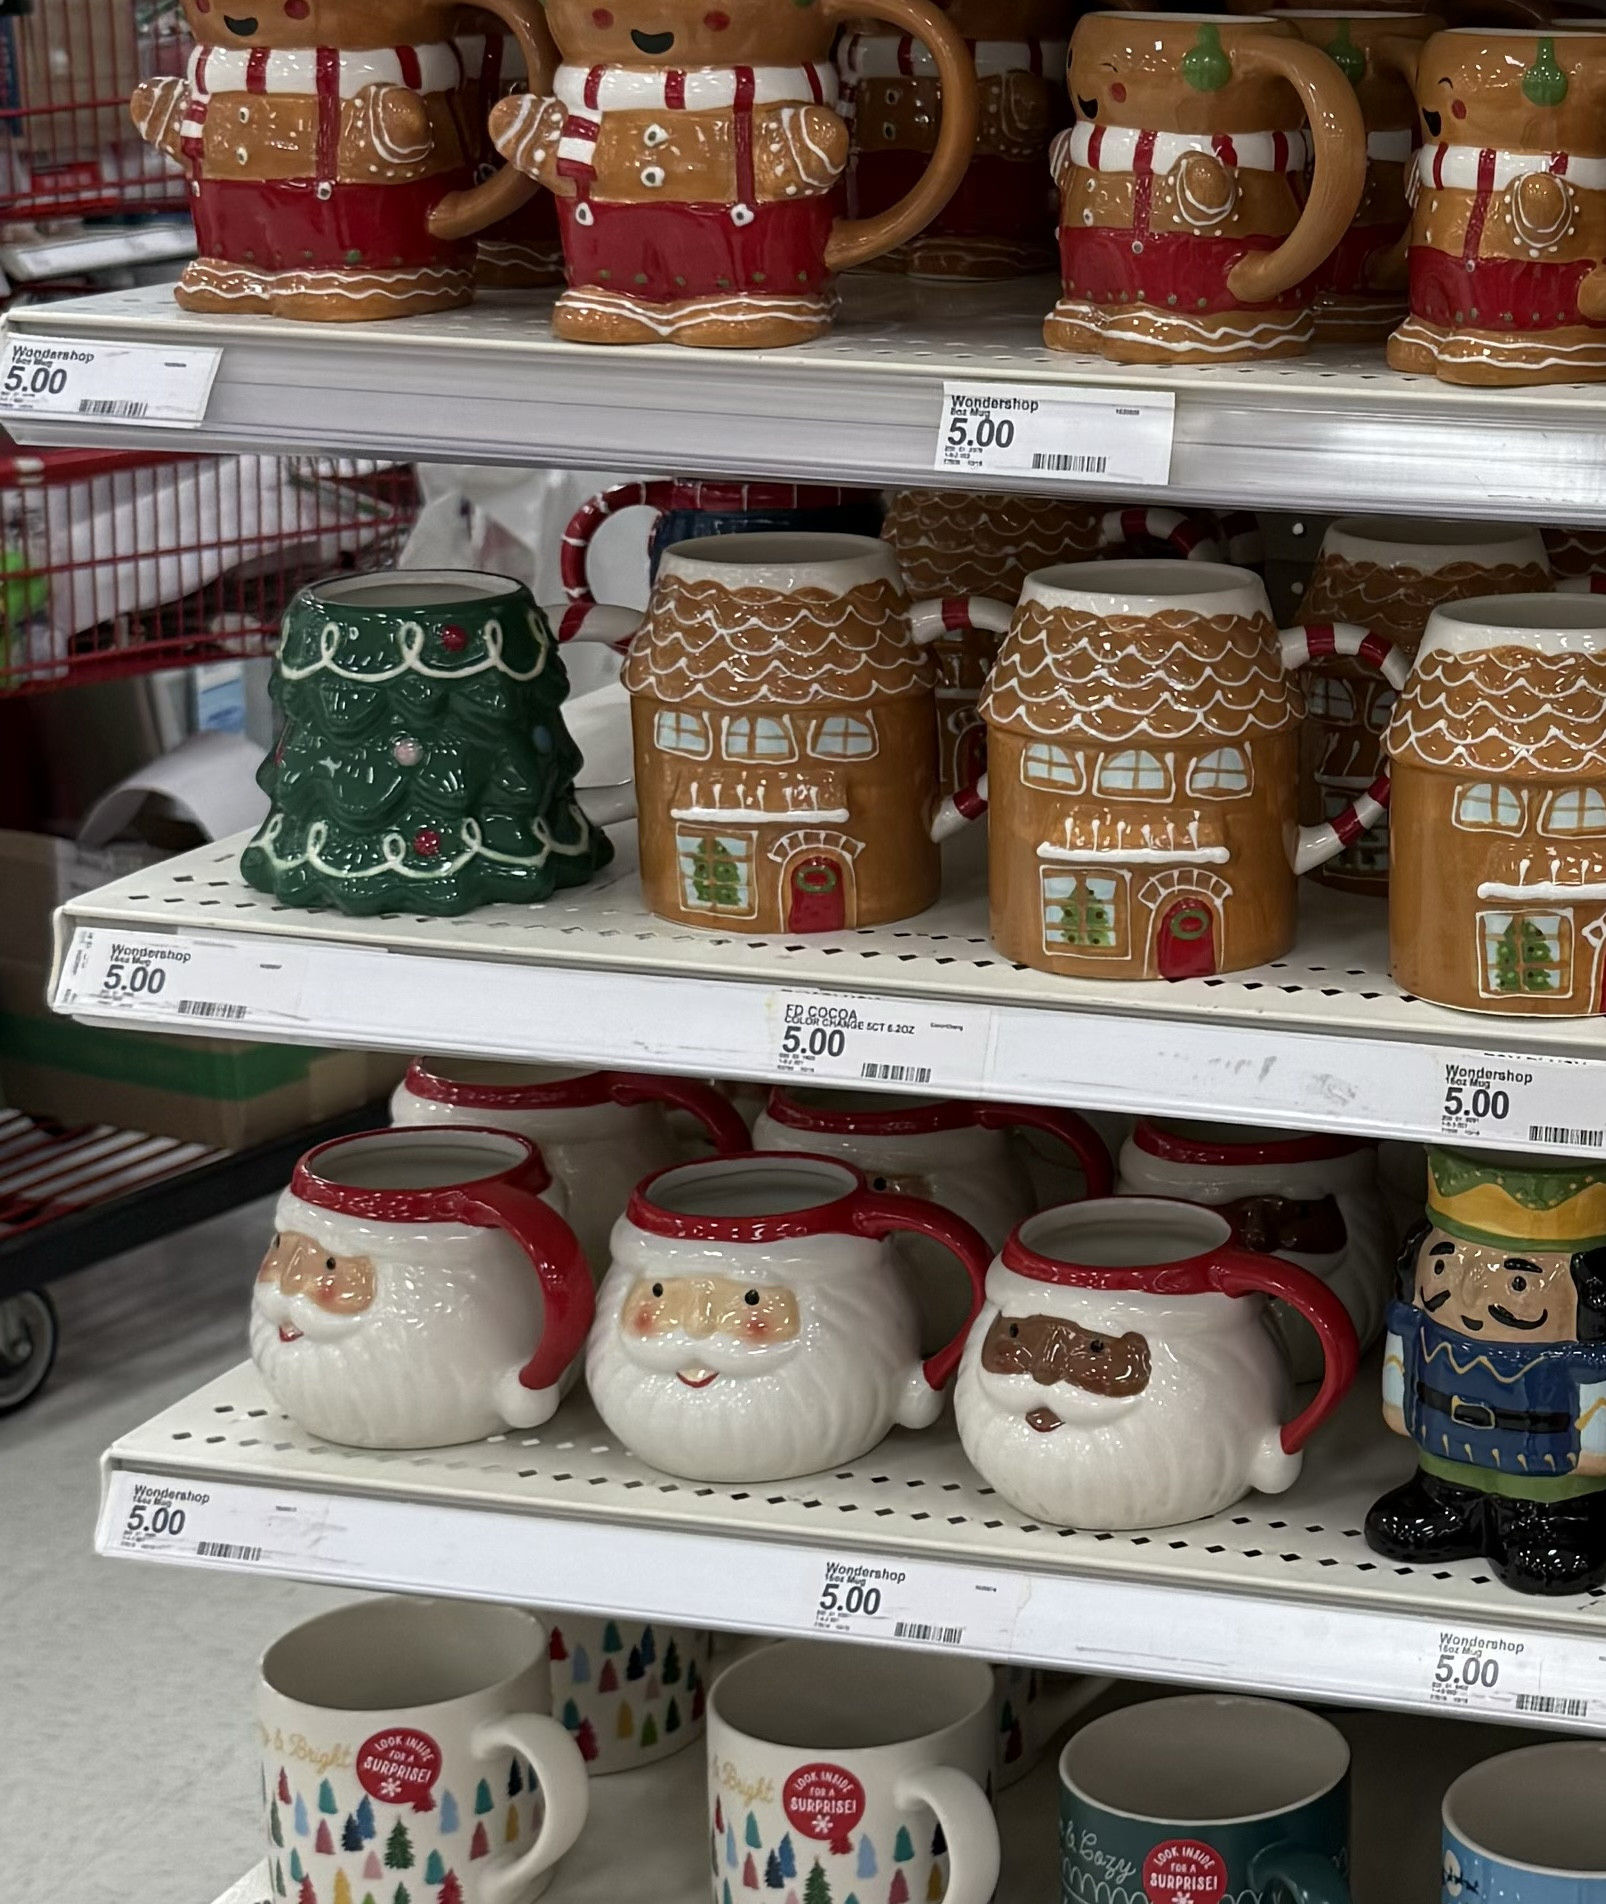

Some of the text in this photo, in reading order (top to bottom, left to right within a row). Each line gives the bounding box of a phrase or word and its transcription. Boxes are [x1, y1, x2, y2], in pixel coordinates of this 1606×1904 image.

[13, 344, 95, 363] Wondershop
[4, 365, 67, 394] 5.00
[952, 395, 1038, 414] Wondershop
[948, 417, 1015, 448] 5.00
[112, 944, 191, 963] Wondershop
[103, 964, 165, 994] 5.00
[808, 1005, 858, 1022] COCOA
[783, 1026, 845, 1057] 5.00
[1445, 1063, 1532, 1084] Wondershop
[1443, 1086, 1509, 1119] 5.00
[135, 1484, 210, 1505] Wondershop
[127, 1505, 185, 1535] 5.00
[826, 1561, 906, 1584] Wondershop
[820, 1583, 881, 1615] 5.00
[1440, 1632, 1524, 1655] Wondershop
[1435, 1654, 1499, 1688] 5.00
[374, 1735, 403, 1752] LOOK
[363, 1756, 432, 1783] SURPRISE!
[794, 1771, 818, 1791] LOOK
[790, 1797, 857, 1814] SURPRISE!
[1079, 1829, 1137, 1885] Cozy
[1152, 1846, 1215, 1869] LOOK INSIDE
[1150, 1872, 1217, 1891] SURPRISE!
